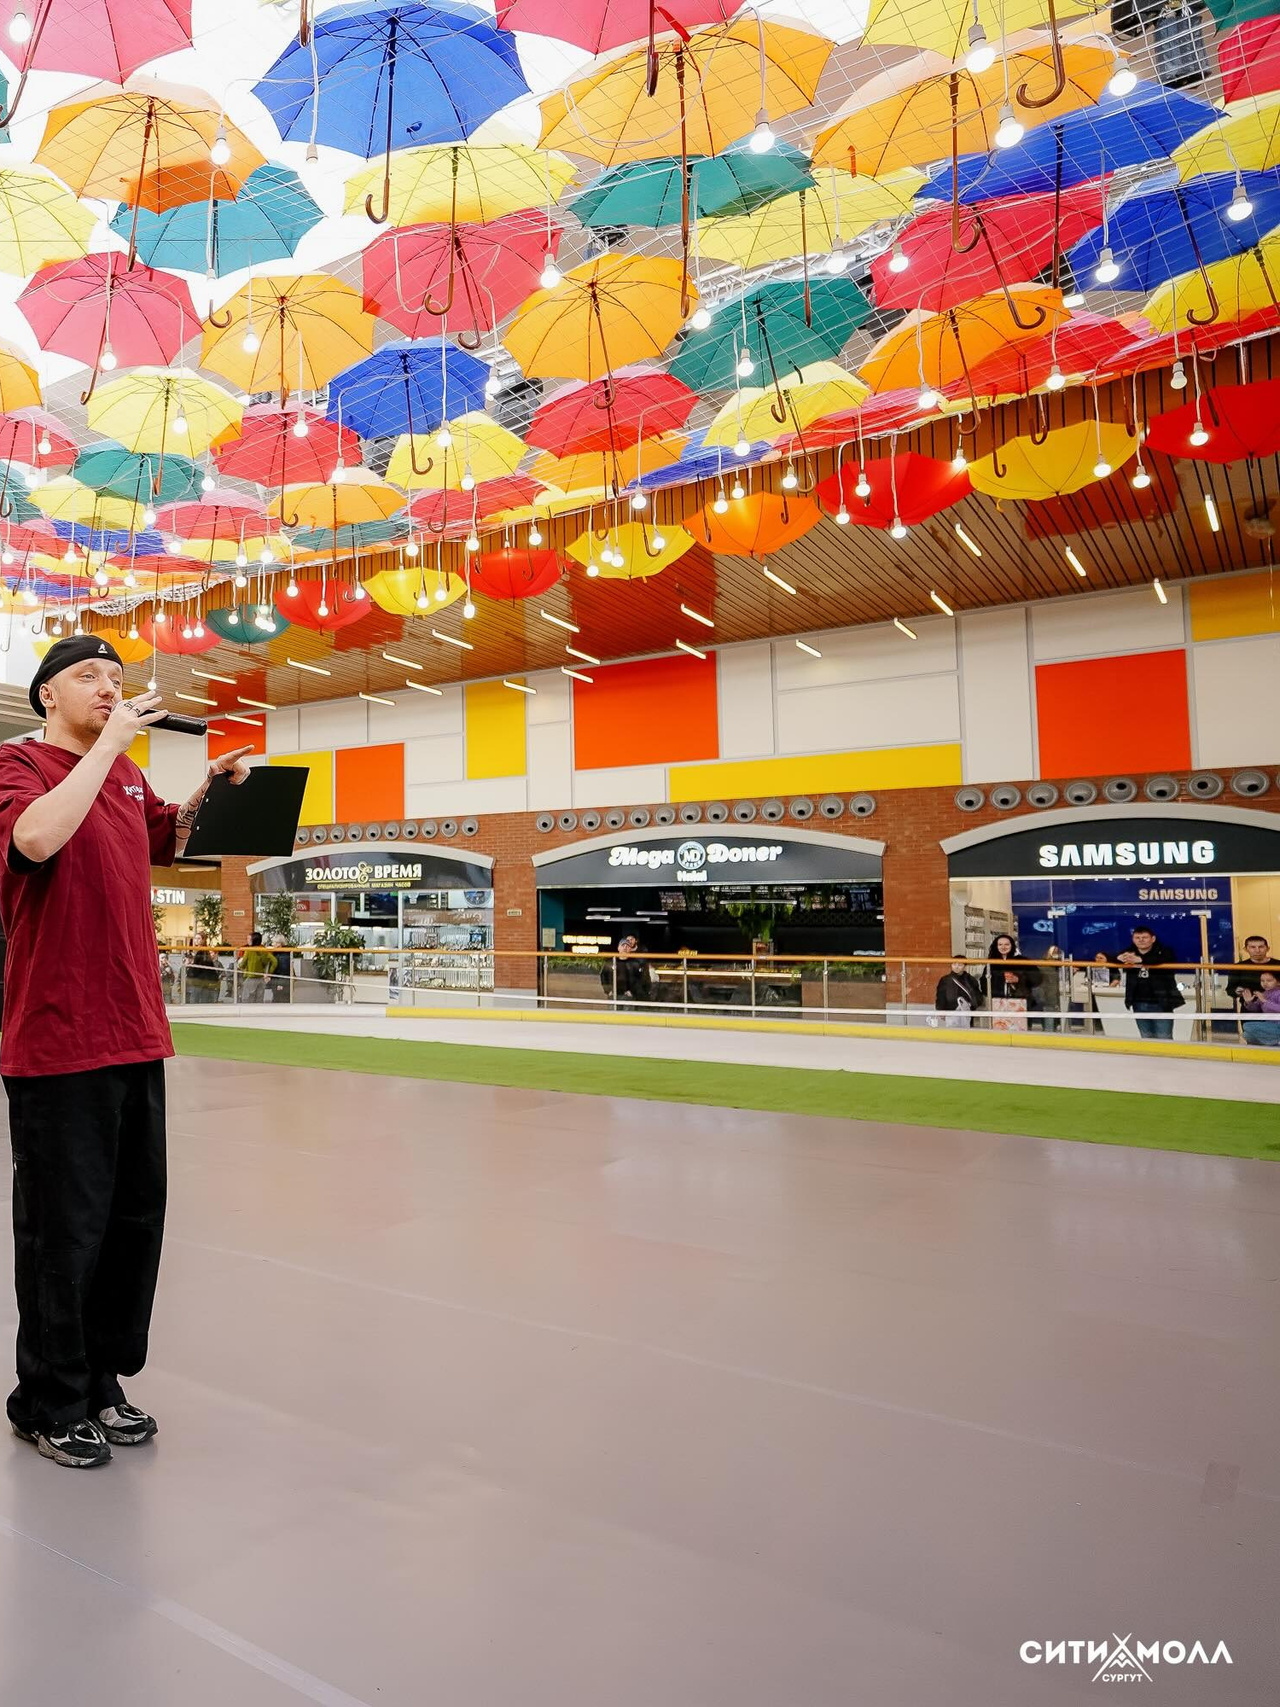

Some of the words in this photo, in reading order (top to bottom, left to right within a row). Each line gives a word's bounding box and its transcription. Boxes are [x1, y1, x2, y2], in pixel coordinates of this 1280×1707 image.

[608, 846, 675, 870] Mega
[706, 843, 783, 864] Doner
[1038, 840, 1215, 868] SAMSUNG
[305, 867, 359, 882] ЗОЛОТО
[374, 863, 423, 879] ВРЕМЯ
[1138, 888, 1219, 901] SAMSUNG
